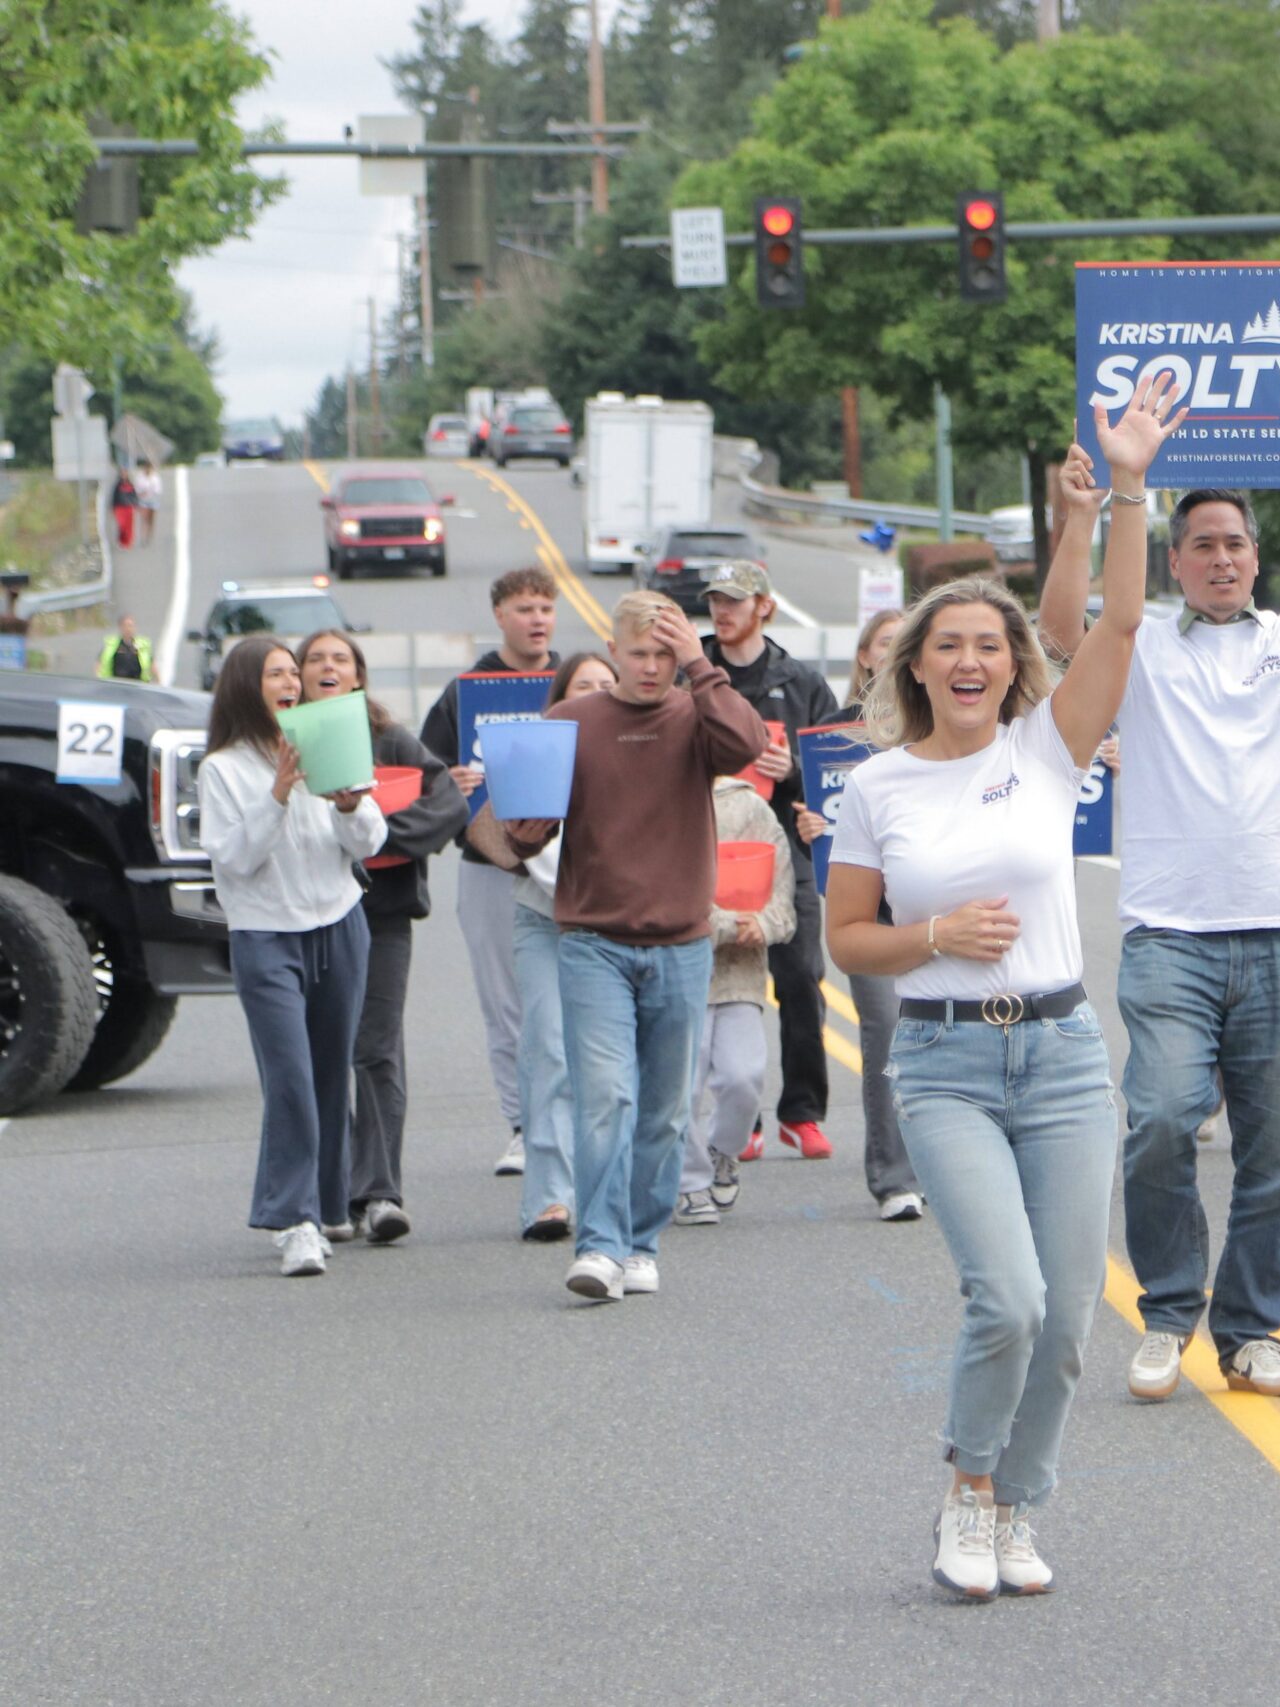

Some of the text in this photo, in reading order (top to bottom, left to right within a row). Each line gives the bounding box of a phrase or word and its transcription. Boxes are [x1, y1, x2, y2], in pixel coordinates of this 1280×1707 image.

[1099, 269, 1140, 277] HOME
[1150, 269, 1165, 277] IS
[1176, 269, 1228, 277] WORTH
[1099, 322, 1235, 345] KRISTINA
[1192, 428, 1208, 439] LD
[1213, 428, 1256, 439] STATE
[66, 722, 114, 756] 22
[982, 776, 1020, 805] SOLTS
